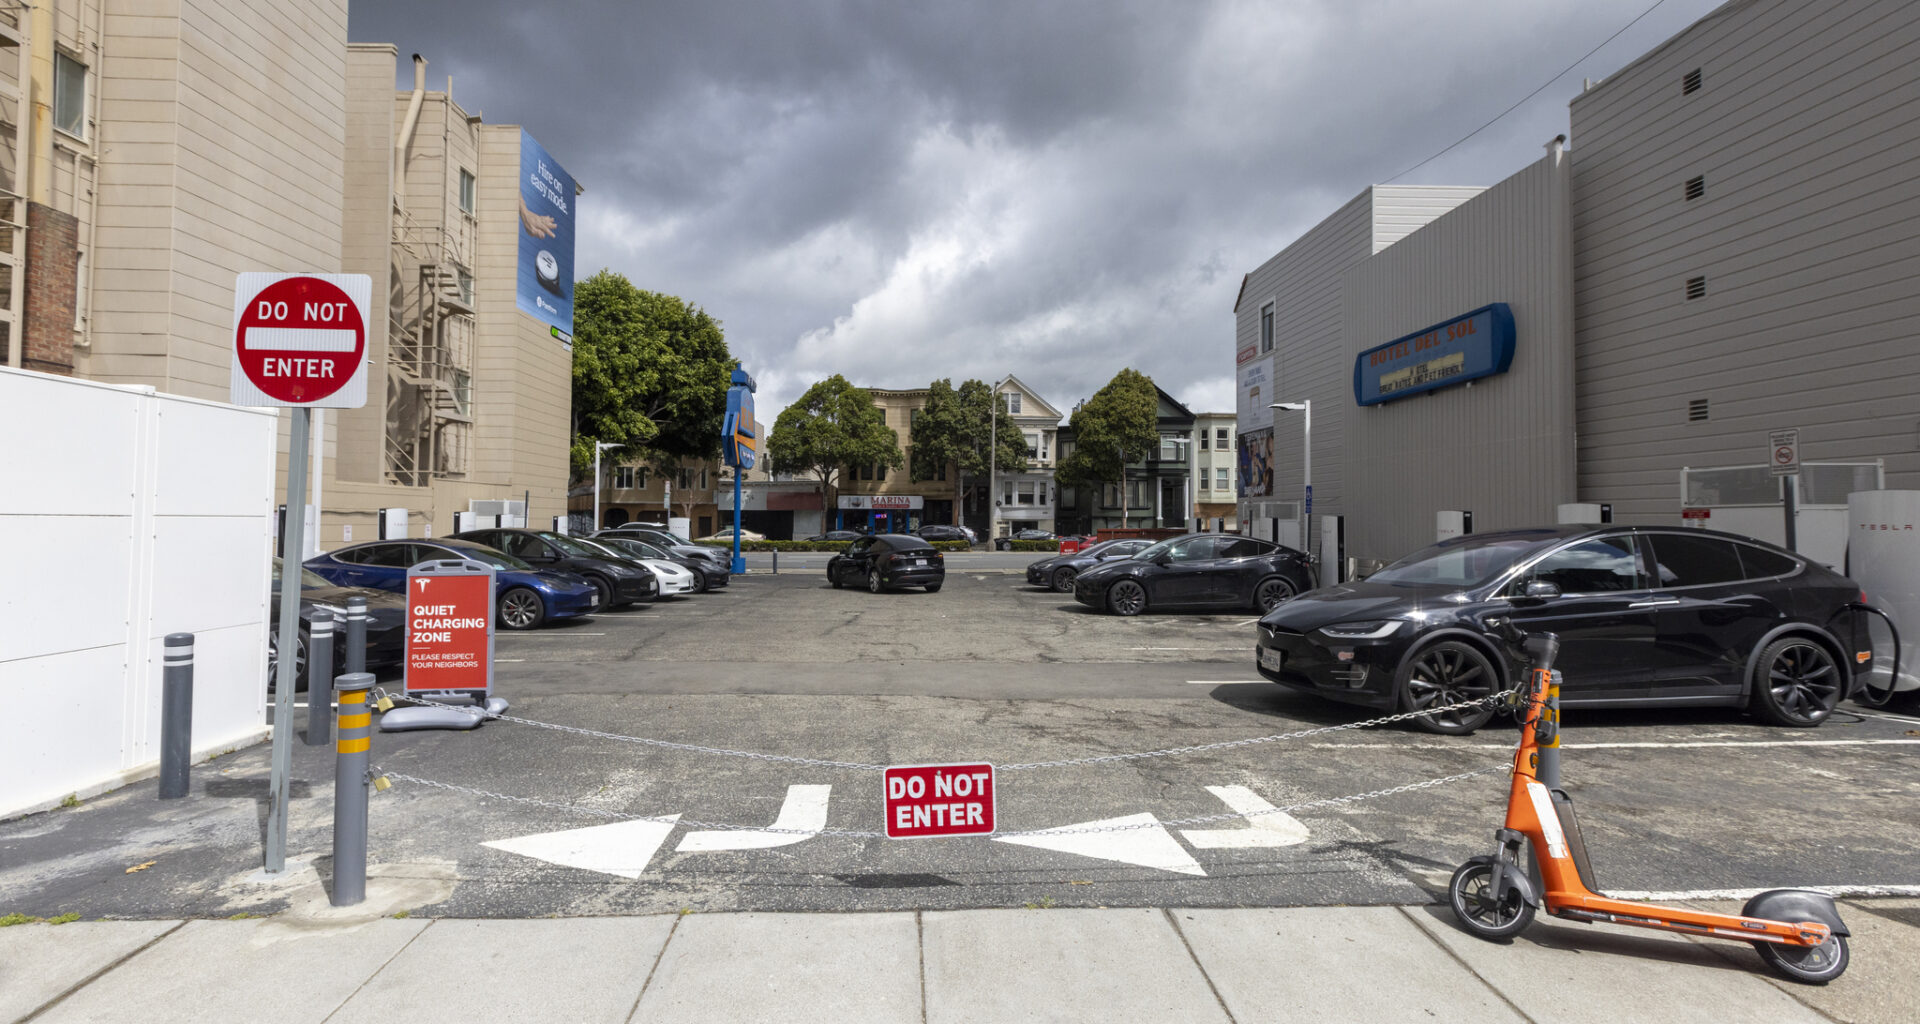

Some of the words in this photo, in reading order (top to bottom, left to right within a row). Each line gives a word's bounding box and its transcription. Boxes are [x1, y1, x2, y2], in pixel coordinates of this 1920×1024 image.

[538, 160, 553, 184] Hire
[553, 178, 563, 194] on
[530, 173, 548, 198] easy
[547, 188, 568, 215] mode.
[258, 301, 288, 320] DO
[303, 302, 348, 322] NOT
[1370, 342, 1411, 368] HOTEL
[1415, 331, 1441, 352] DEL
[1447, 319, 1477, 342] SOL
[263, 358, 335, 378] ENTER
[871, 496, 911, 505] MARINA
[413, 605, 456, 616] QUIET
[413, 618, 485, 629] CHARGING
[413, 632, 451, 642] ZONE
[889, 775, 926, 800] DO
[934, 773, 989, 798] NOT
[896, 802, 985, 829] ENTER
